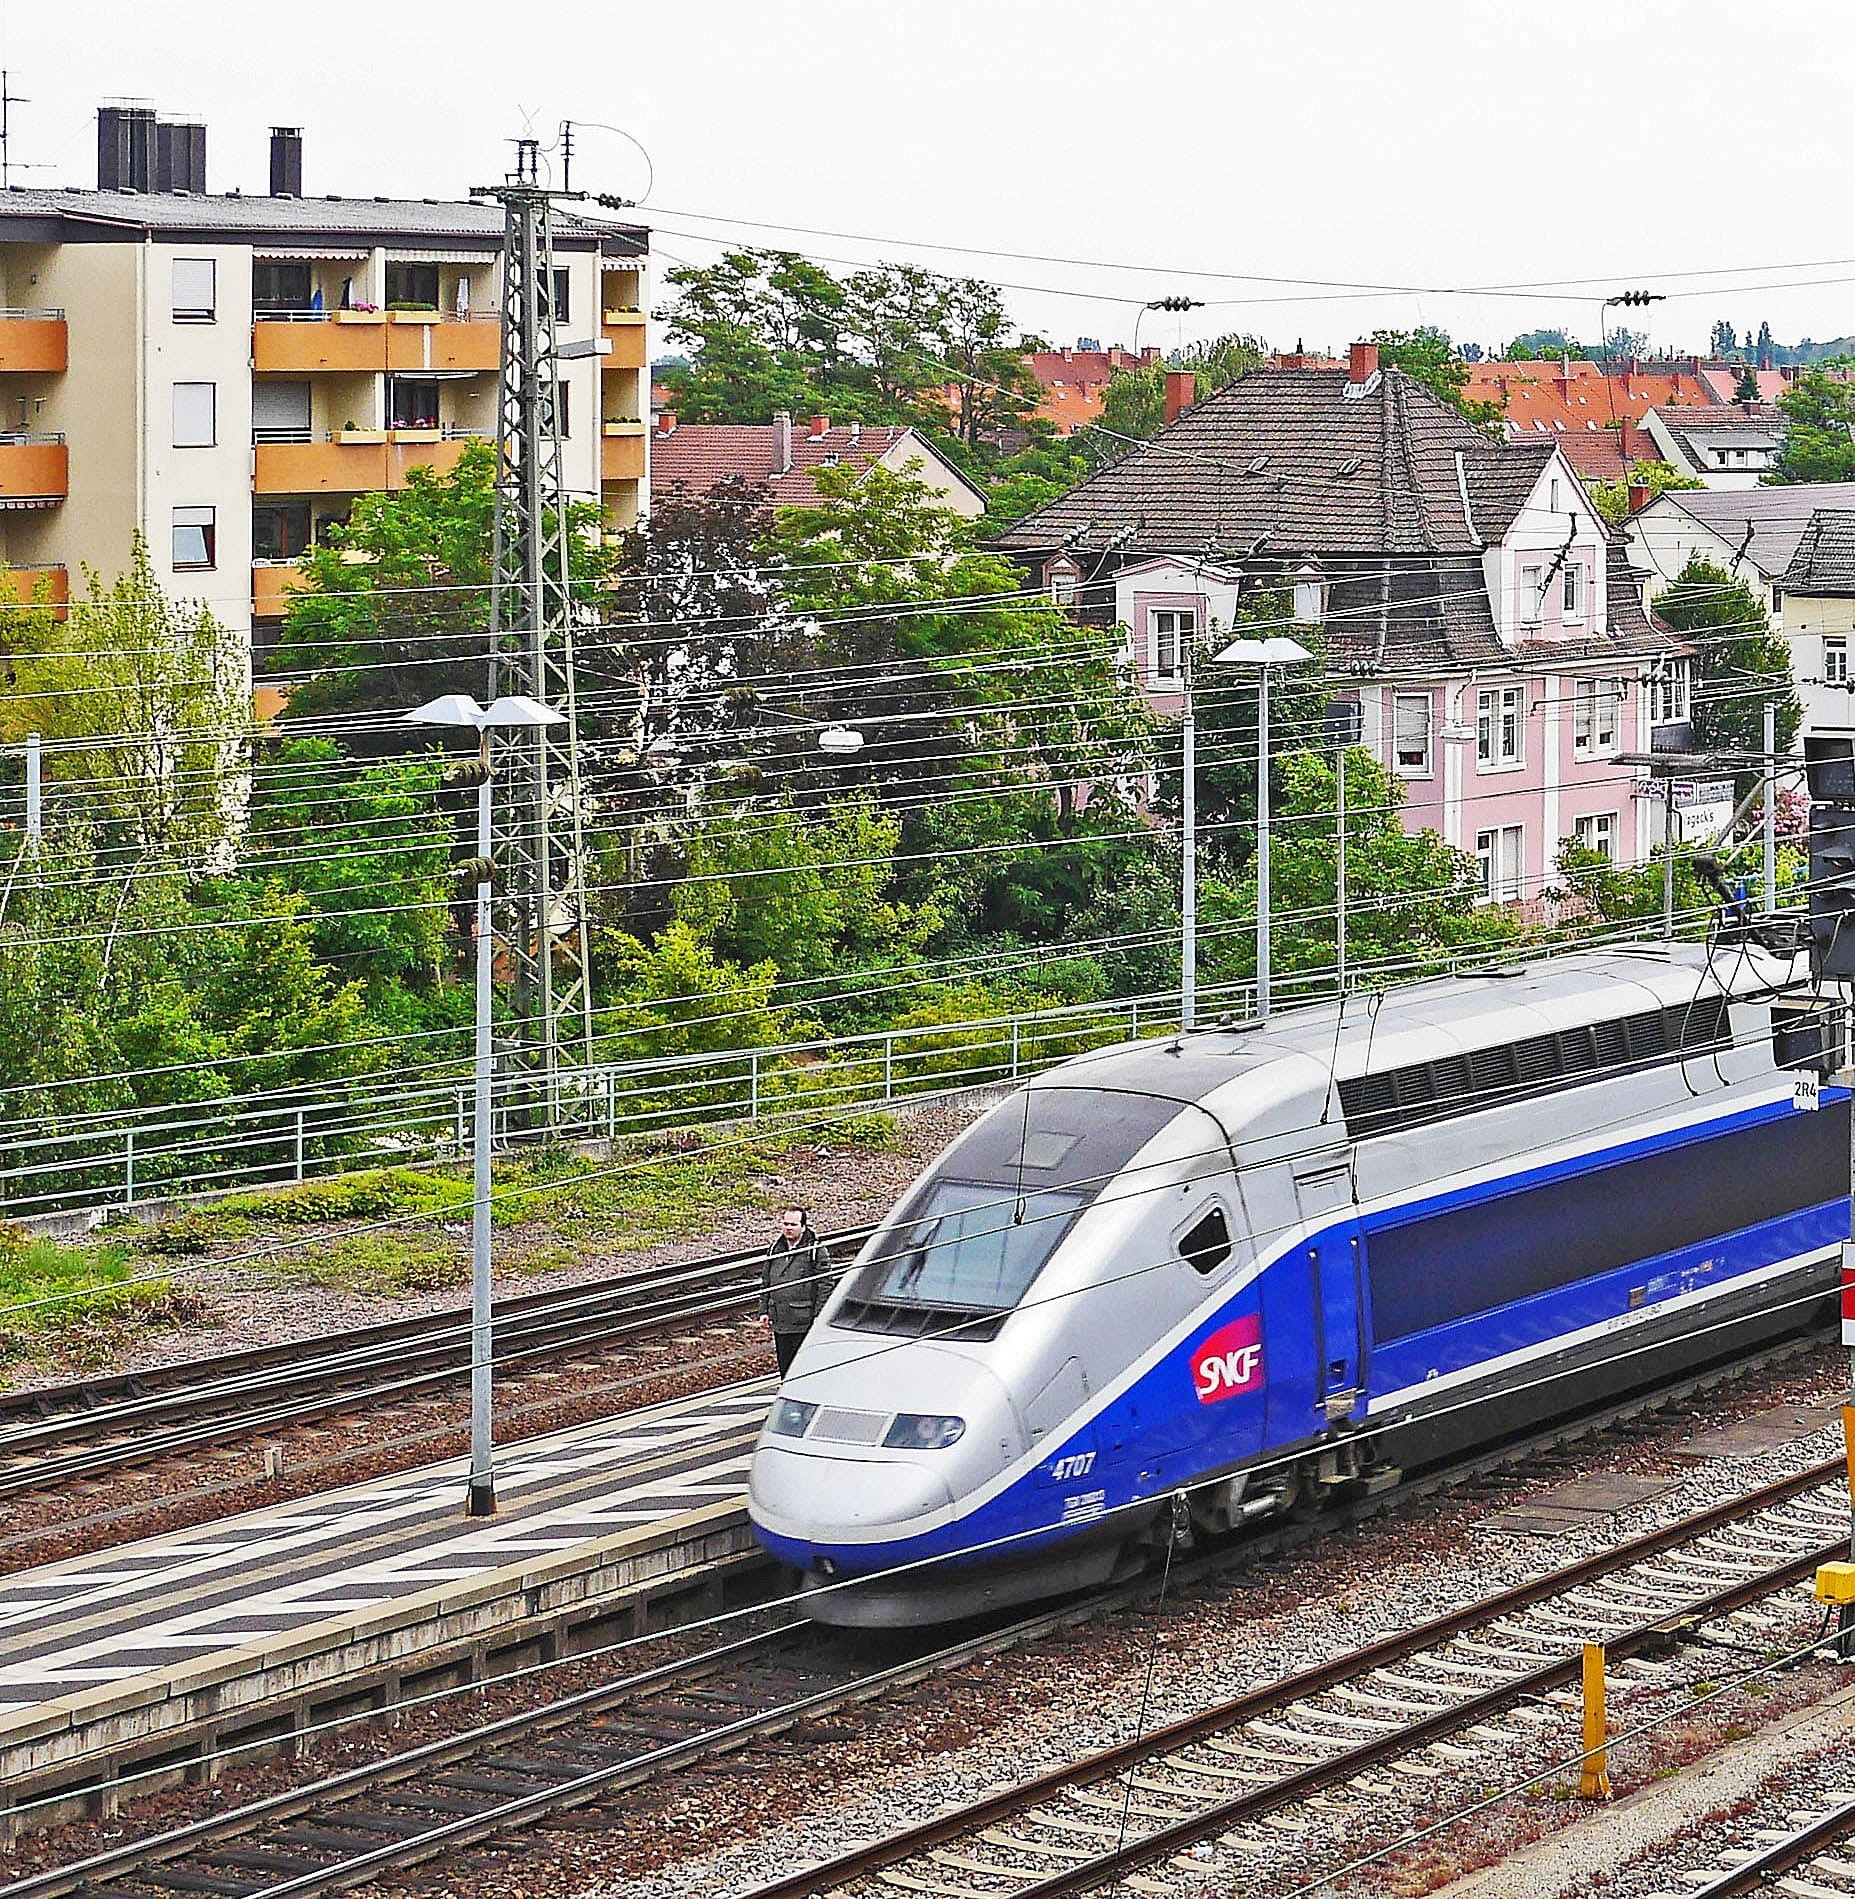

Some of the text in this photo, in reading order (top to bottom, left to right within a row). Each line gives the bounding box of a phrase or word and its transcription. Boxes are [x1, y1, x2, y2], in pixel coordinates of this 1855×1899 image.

[1794, 1081, 1817, 1098] 2R4
[1199, 1343, 1262, 1395] SNCF
[1051, 1451, 1097, 1481] 4707
